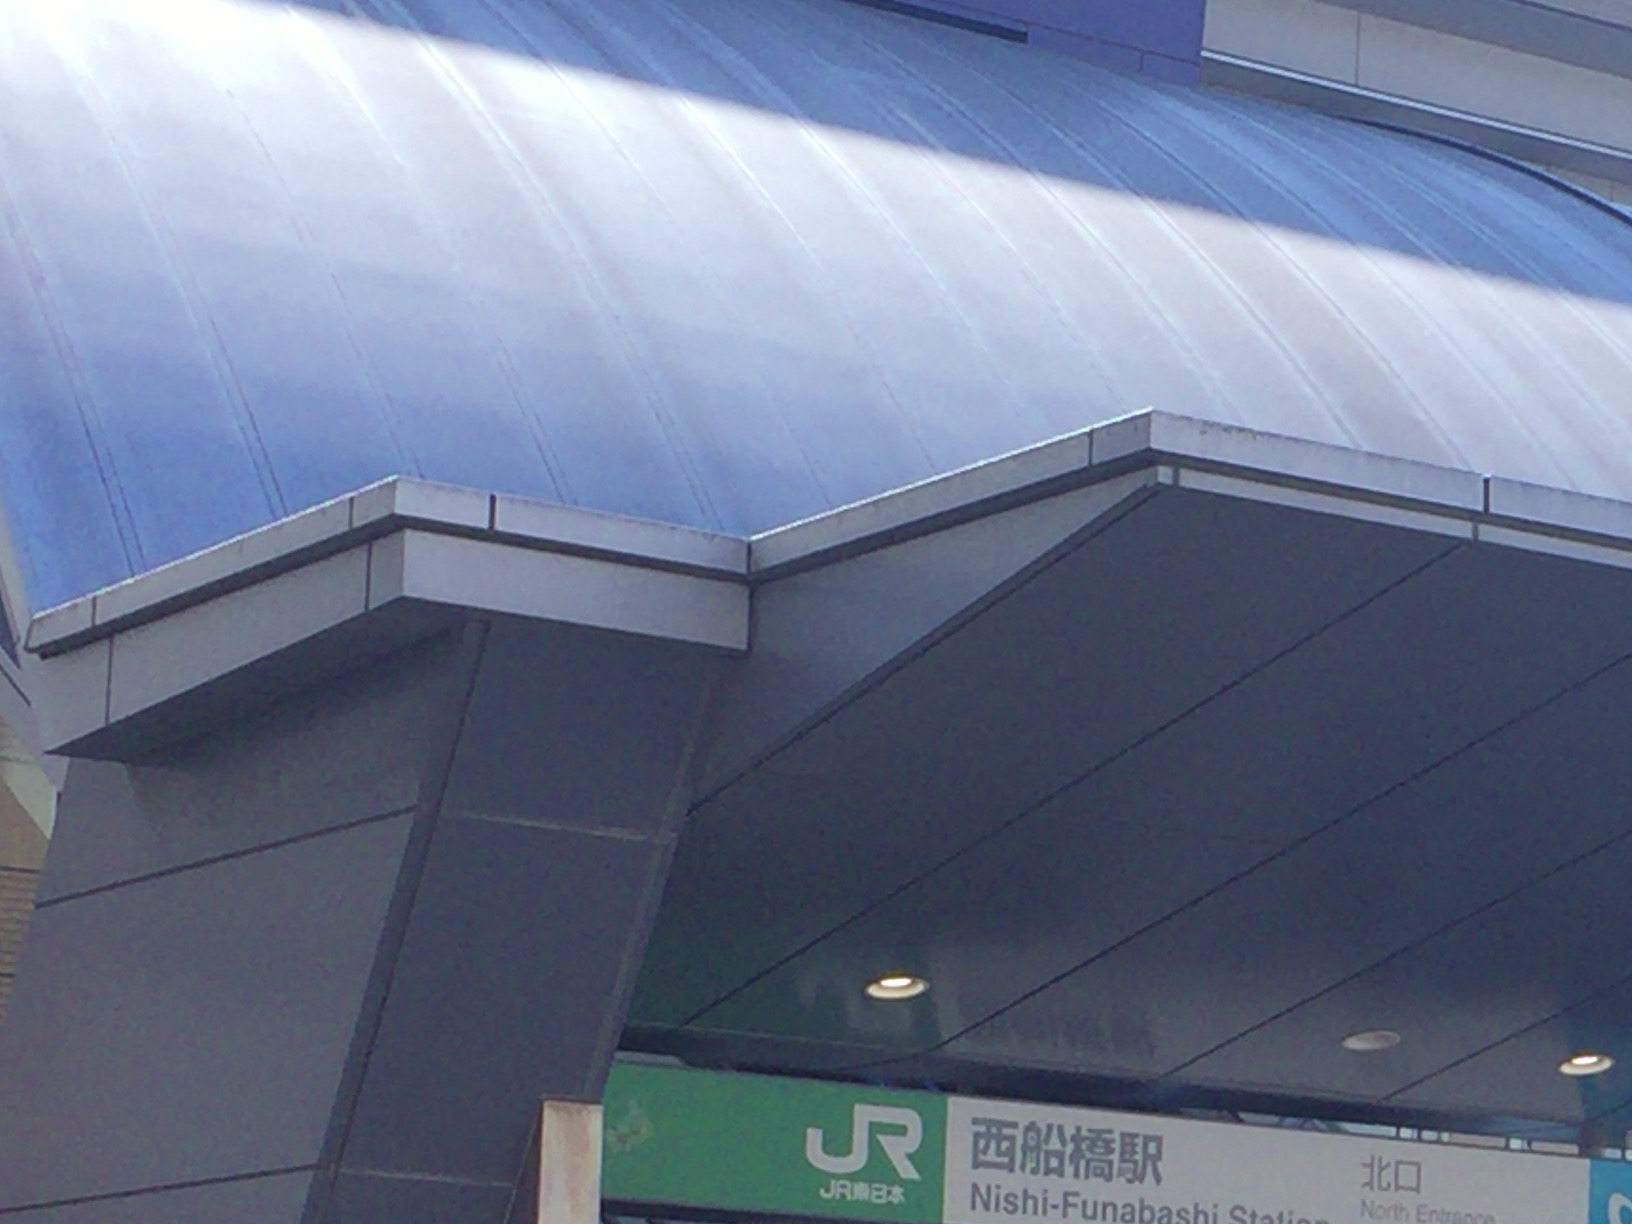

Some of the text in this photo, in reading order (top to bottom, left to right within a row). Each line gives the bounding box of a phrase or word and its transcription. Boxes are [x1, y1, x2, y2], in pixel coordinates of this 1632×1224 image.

[806, 1103, 923, 1180] JR
[971, 1117, 1165, 1186] 西船橋駅
[819, 1178, 906, 1204] JR東日本
[1361, 1155, 1422, 1194] 北口
[1360, 1199, 1409, 1223] North
